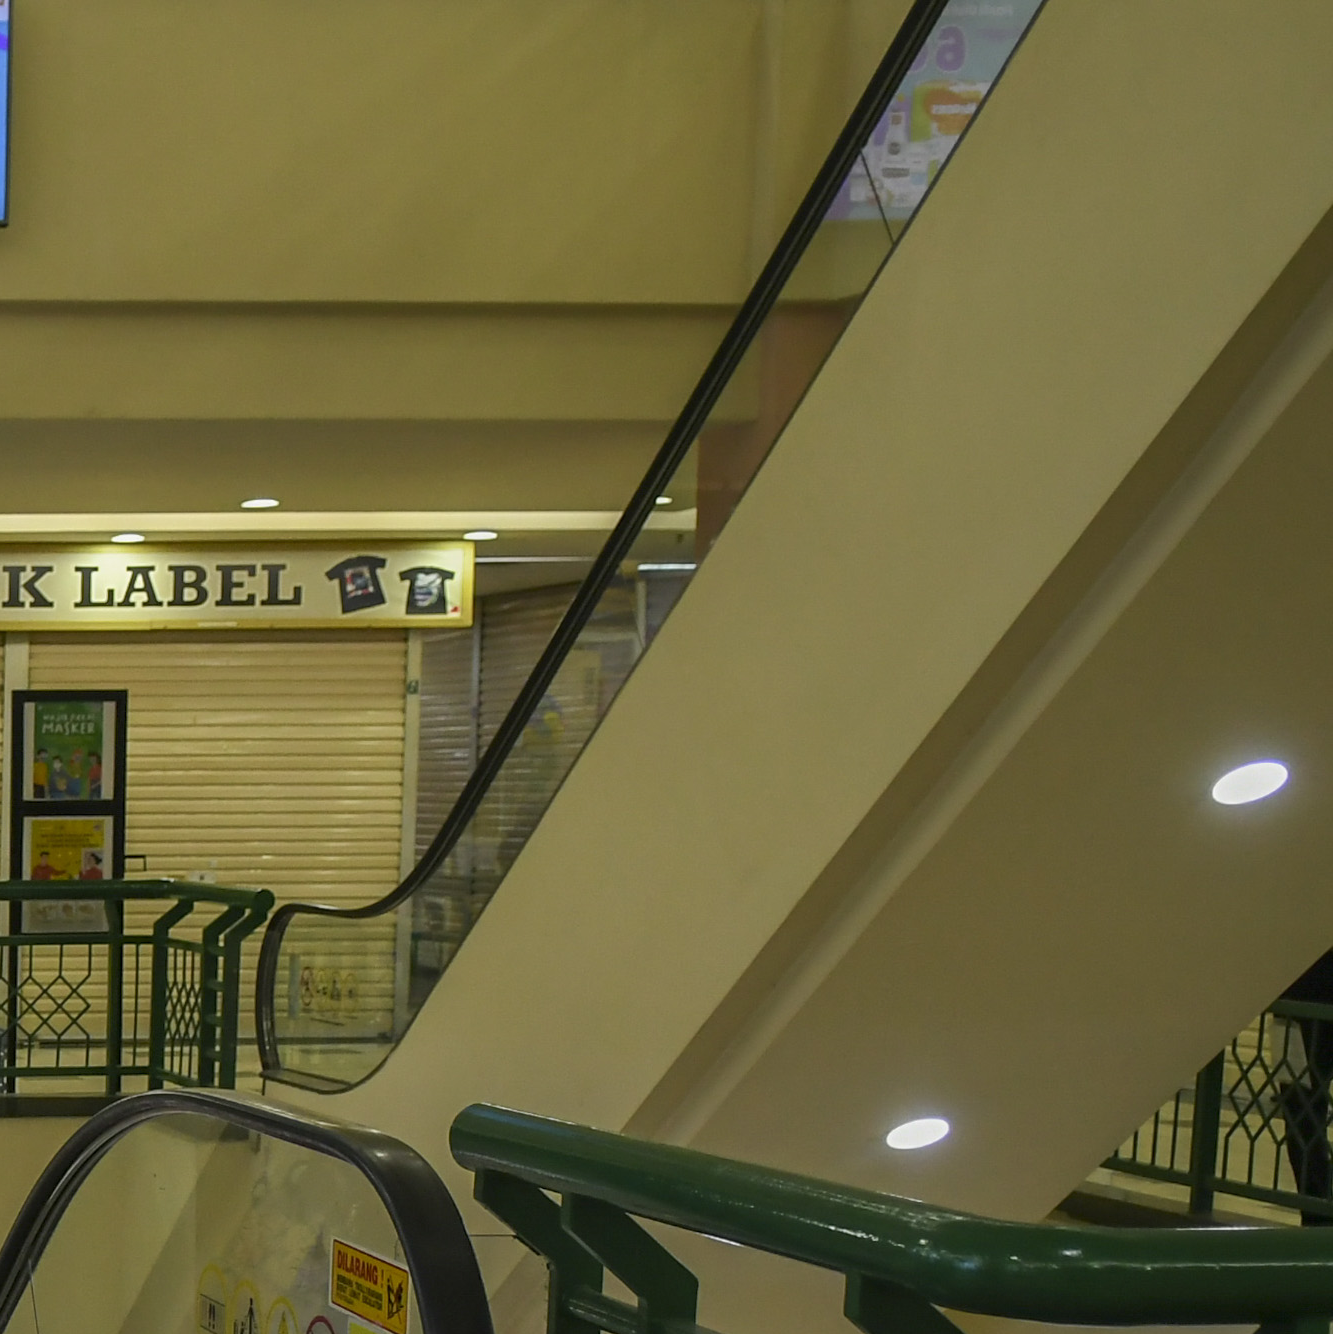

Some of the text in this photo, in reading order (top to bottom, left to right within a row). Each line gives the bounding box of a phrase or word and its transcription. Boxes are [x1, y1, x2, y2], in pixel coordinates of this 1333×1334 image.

[73, 562, 303, 609] LABEL
[41, 721, 96, 736] MASKER
[337, 1249, 379, 1286] DILARANG
